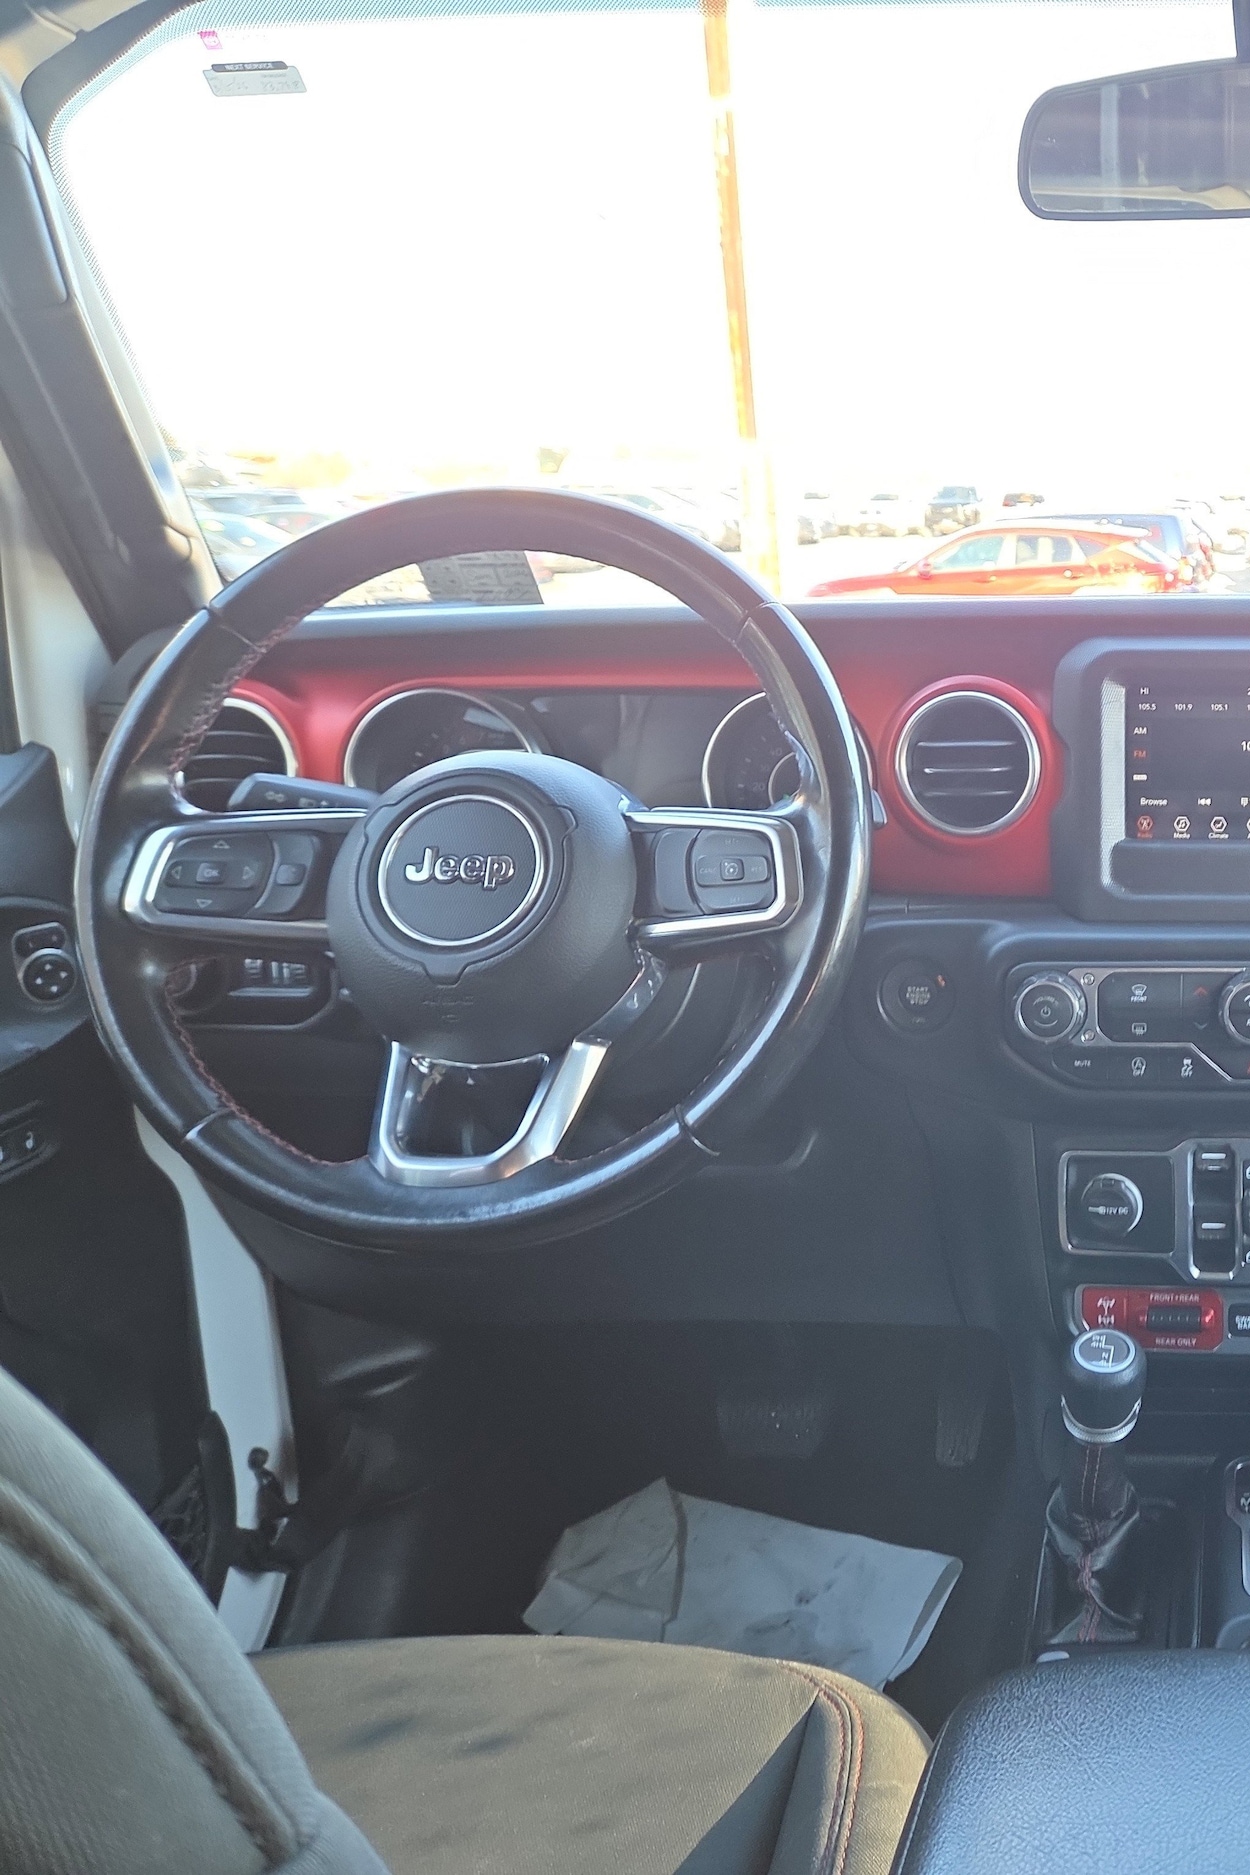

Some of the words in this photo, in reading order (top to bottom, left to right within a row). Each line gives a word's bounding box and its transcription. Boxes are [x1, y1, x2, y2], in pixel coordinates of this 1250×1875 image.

[1140, 686, 1150, 695] HI
[1138, 703, 1157, 711] 105.5
[1174, 703, 1193, 711] 101.9
[1210, 703, 1228, 711] 105.1
[1133, 727, 1148, 735] AM
[1133, 750, 1147, 758] FM
[1140, 797, 1168, 806] Browse
[404, 845, 517, 892] Jeep
[1074, 1059, 1091, 1067] MUTE
[1176, 1338, 1197, 1347] ONLY
